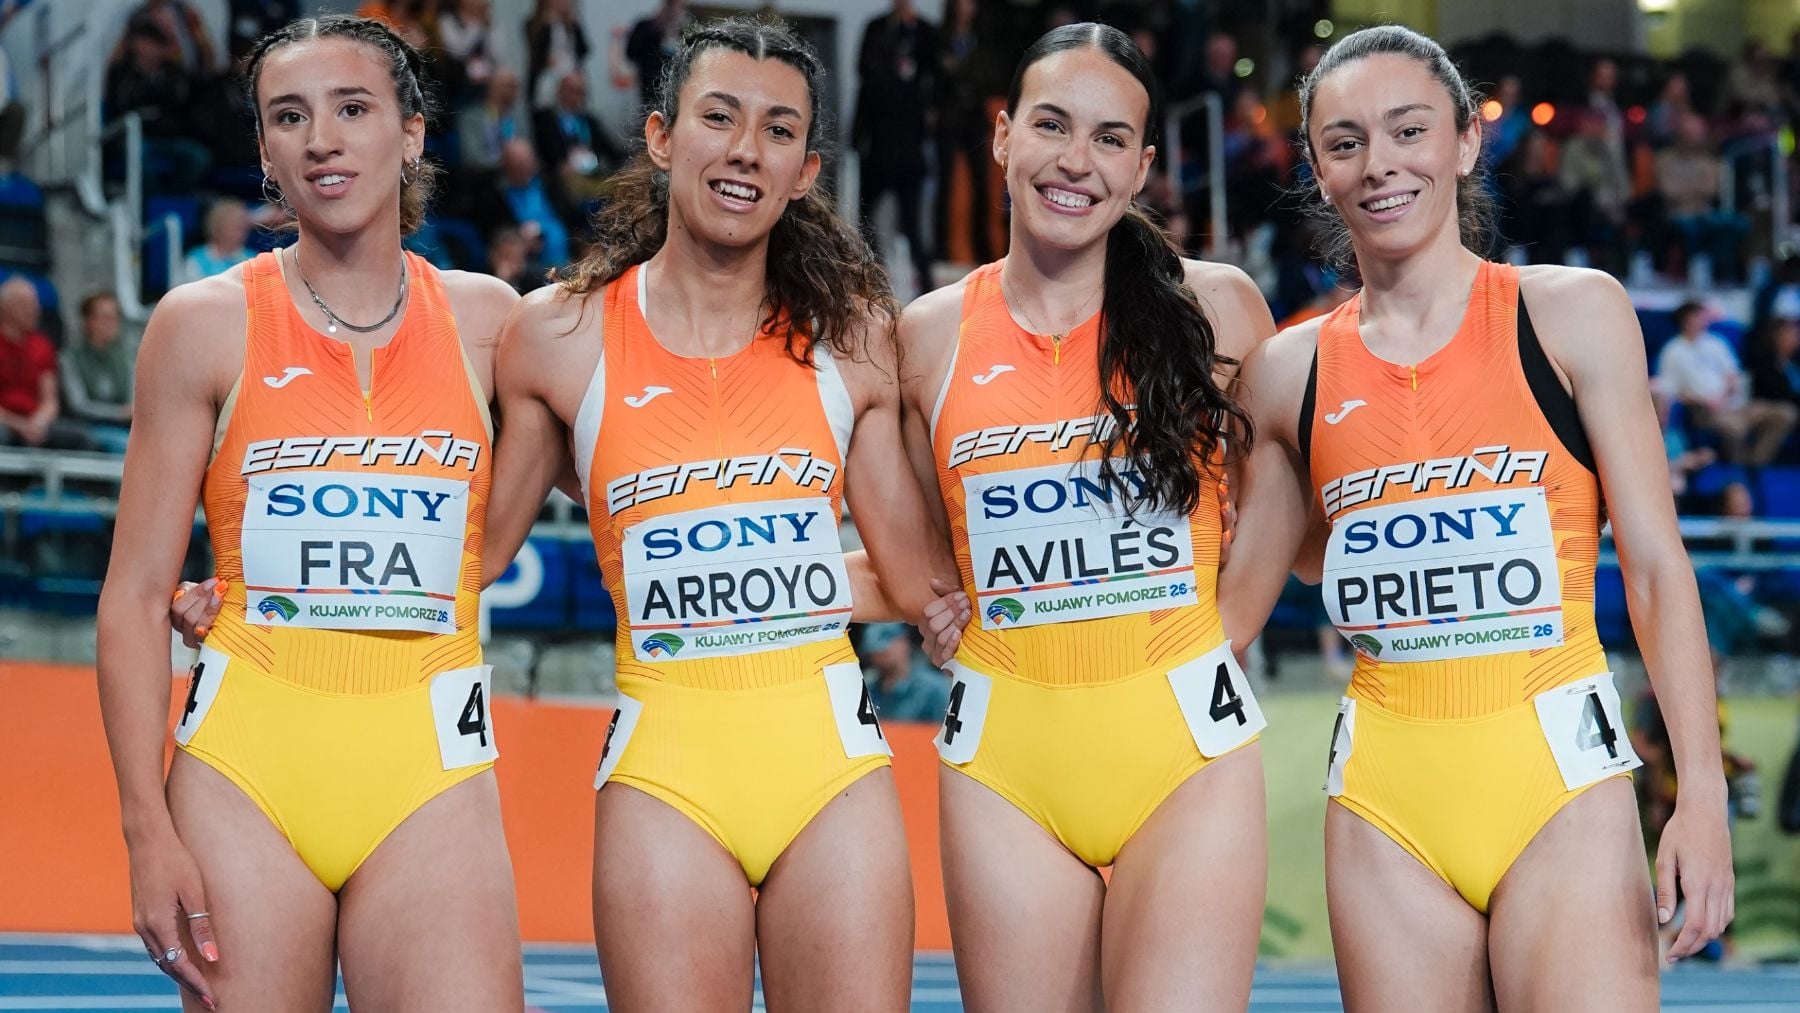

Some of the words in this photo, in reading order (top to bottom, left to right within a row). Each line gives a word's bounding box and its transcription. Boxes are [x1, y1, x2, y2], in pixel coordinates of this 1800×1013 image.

[240, 430, 481, 475] ESPAÑA
[267, 483, 450, 522] SONY
[606, 448, 837, 517] ESPAÑA
[1321, 445, 1550, 521] ESPAÑA
[642, 511, 819, 561] SONY
[986, 520, 1180, 589] AVILÉS
[1344, 502, 1526, 555] SONY
[300, 540, 422, 587] FRA
[309, 604, 372, 618] KUJAWY
[375, 604, 437, 622] POMORZE
[436, 610, 449, 623] 26
[641, 562, 837, 621] ARROYO
[1034, 595, 1093, 614] KUJAWY
[1096, 585, 1167, 606] POMORZE
[1169, 582, 1188, 598] 26
[1337, 558, 1542, 623] PRIETO
[694, 632, 754, 648] KUJAWY
[757, 624, 822, 643] POMORZE
[821, 621, 841, 631] 26
[1391, 634, 1451, 652] KUJAWY
[1454, 626, 1530, 645] POMORZE
[1532, 623, 1554, 638] 26
[456, 681, 488, 748] 4
[1208, 661, 1248, 727] 4
[1575, 691, 1619, 760] 4
